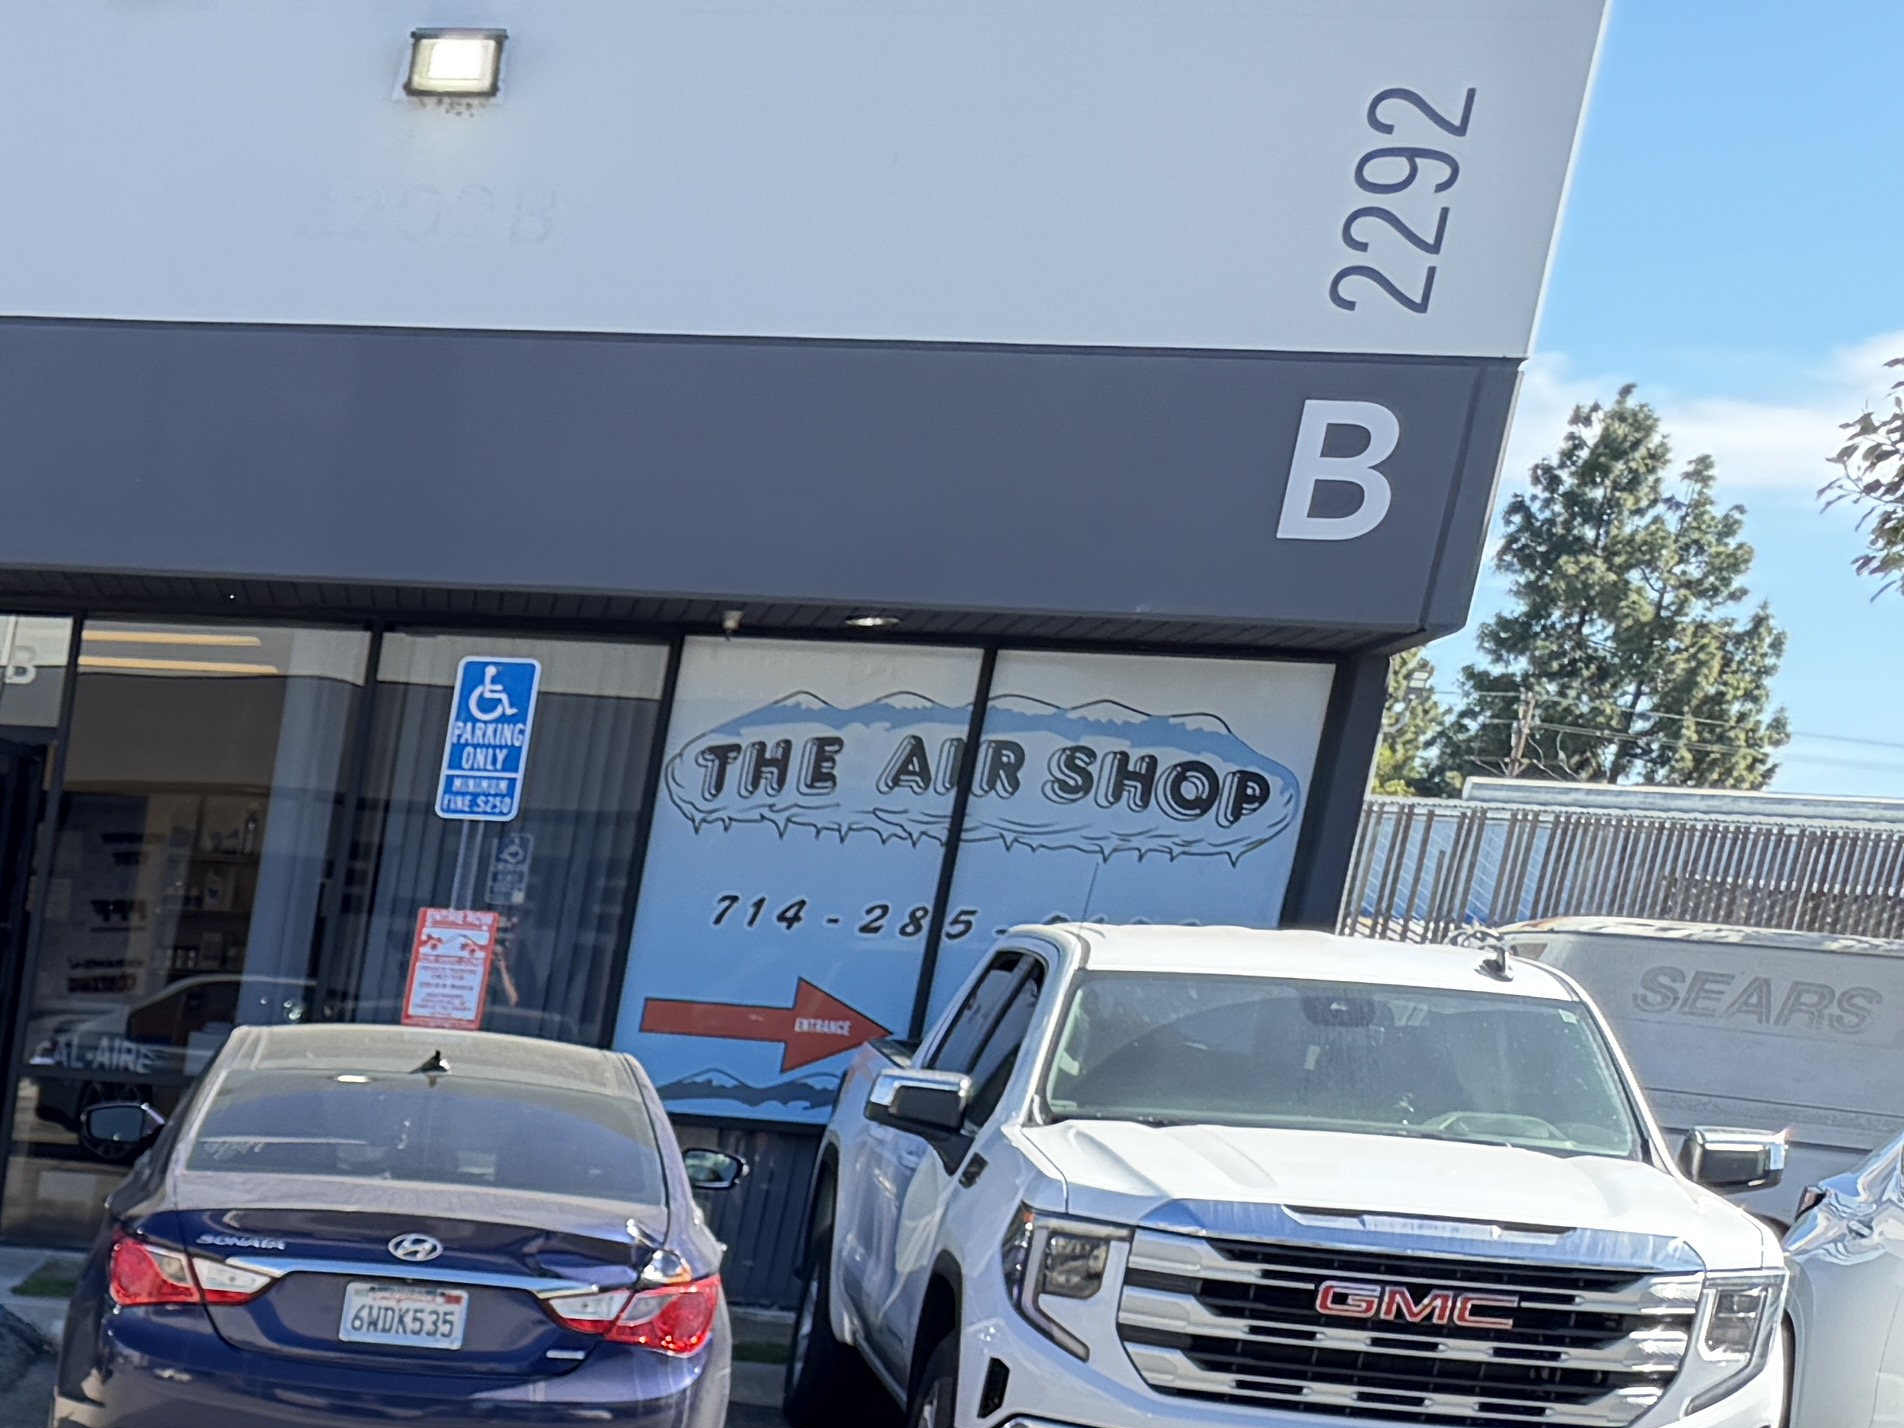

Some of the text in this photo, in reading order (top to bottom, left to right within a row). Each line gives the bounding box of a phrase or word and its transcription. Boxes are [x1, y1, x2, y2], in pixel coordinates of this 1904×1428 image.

[1329, 87, 1477, 315] 2292
[1276, 399, 1401, 541] B
[451, 720, 525, 747] PARKING
[461, 745, 508, 771] ONLY
[452, 777, 509, 795] MINIMUM
[695, 734, 1272, 828] THE AIR SHOP
[442, 794, 512, 814] FINE $250
[1631, 965, 1884, 1035] SEARS
[794, 1016, 851, 1037] ENTRANCE
[195, 1234, 285, 1250] SONATA
[350, 1303, 456, 1339] 6WDK535
[1315, 1280, 1520, 1331] GMC
